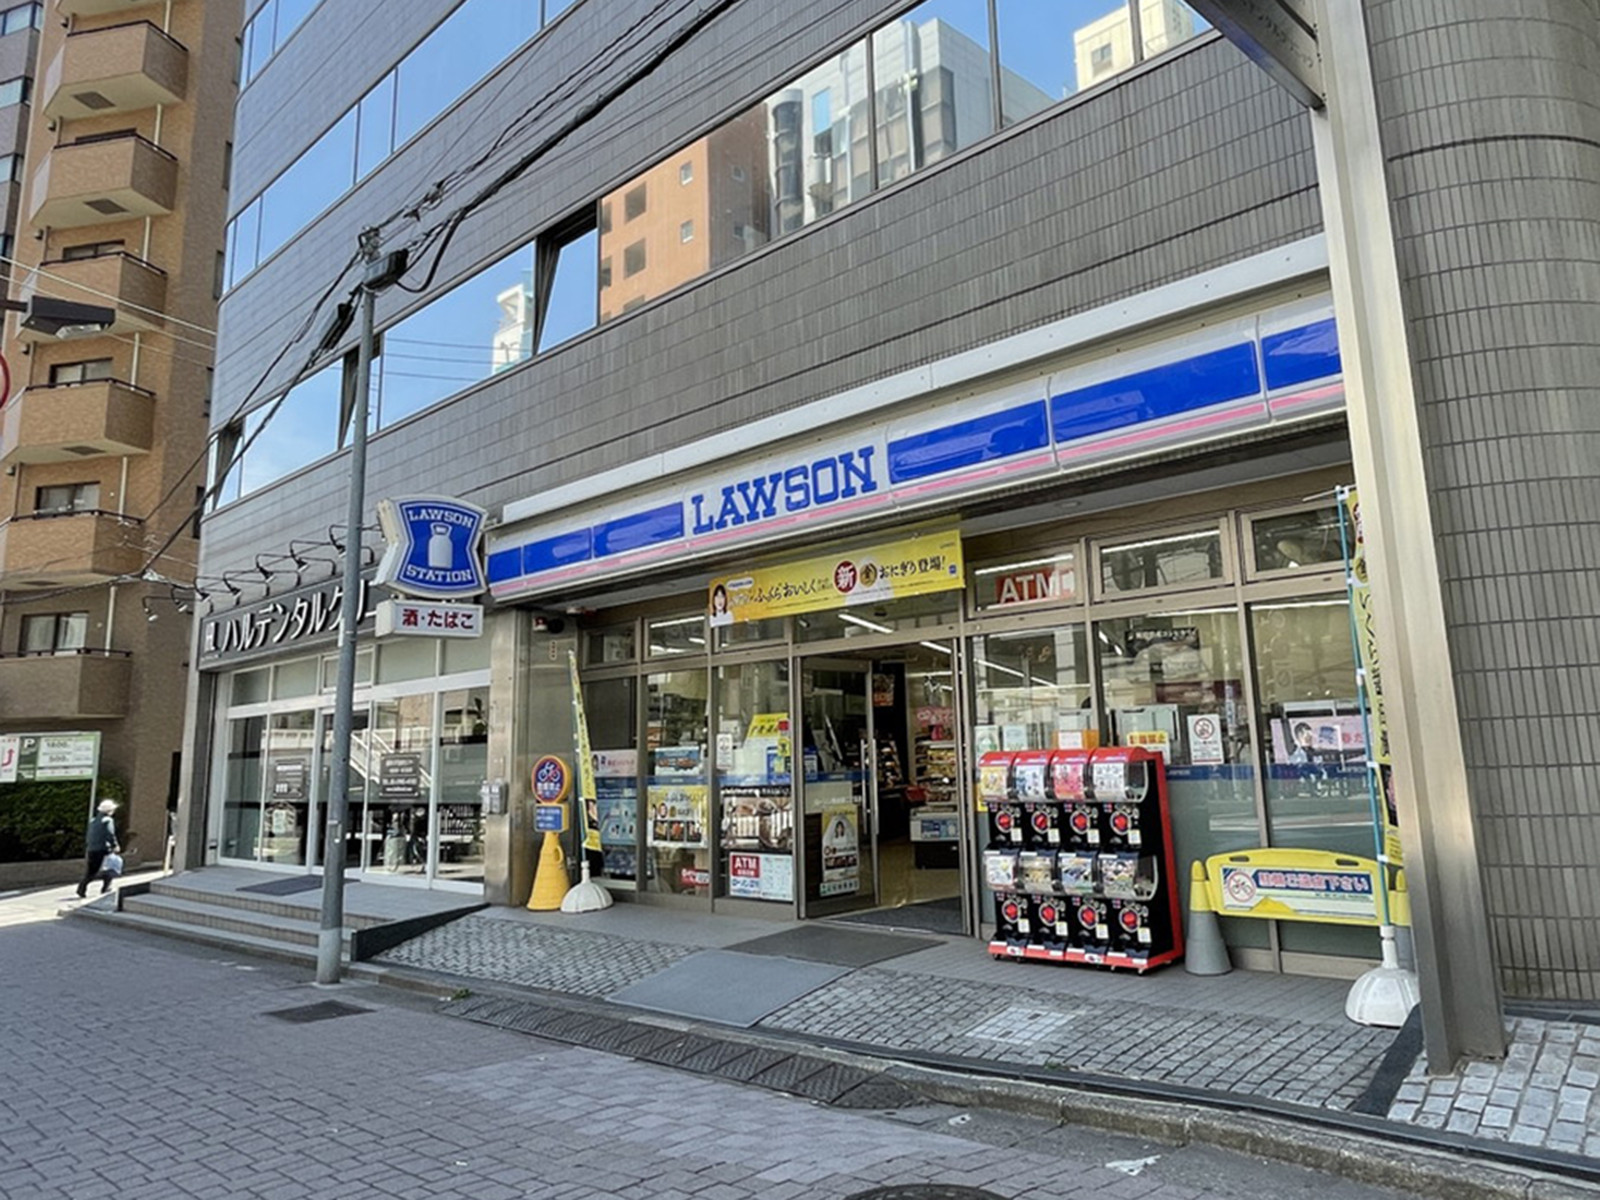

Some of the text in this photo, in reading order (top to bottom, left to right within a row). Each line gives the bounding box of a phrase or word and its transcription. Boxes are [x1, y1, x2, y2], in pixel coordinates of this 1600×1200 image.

[691, 445, 877, 535] LAWSON
[408, 508, 474, 528] LAWSON
[405, 564, 473, 583] STATION
[836, 563, 856, 590] 新
[999, 568, 1060, 604] ATM
[734, 856, 758, 870] ATM
